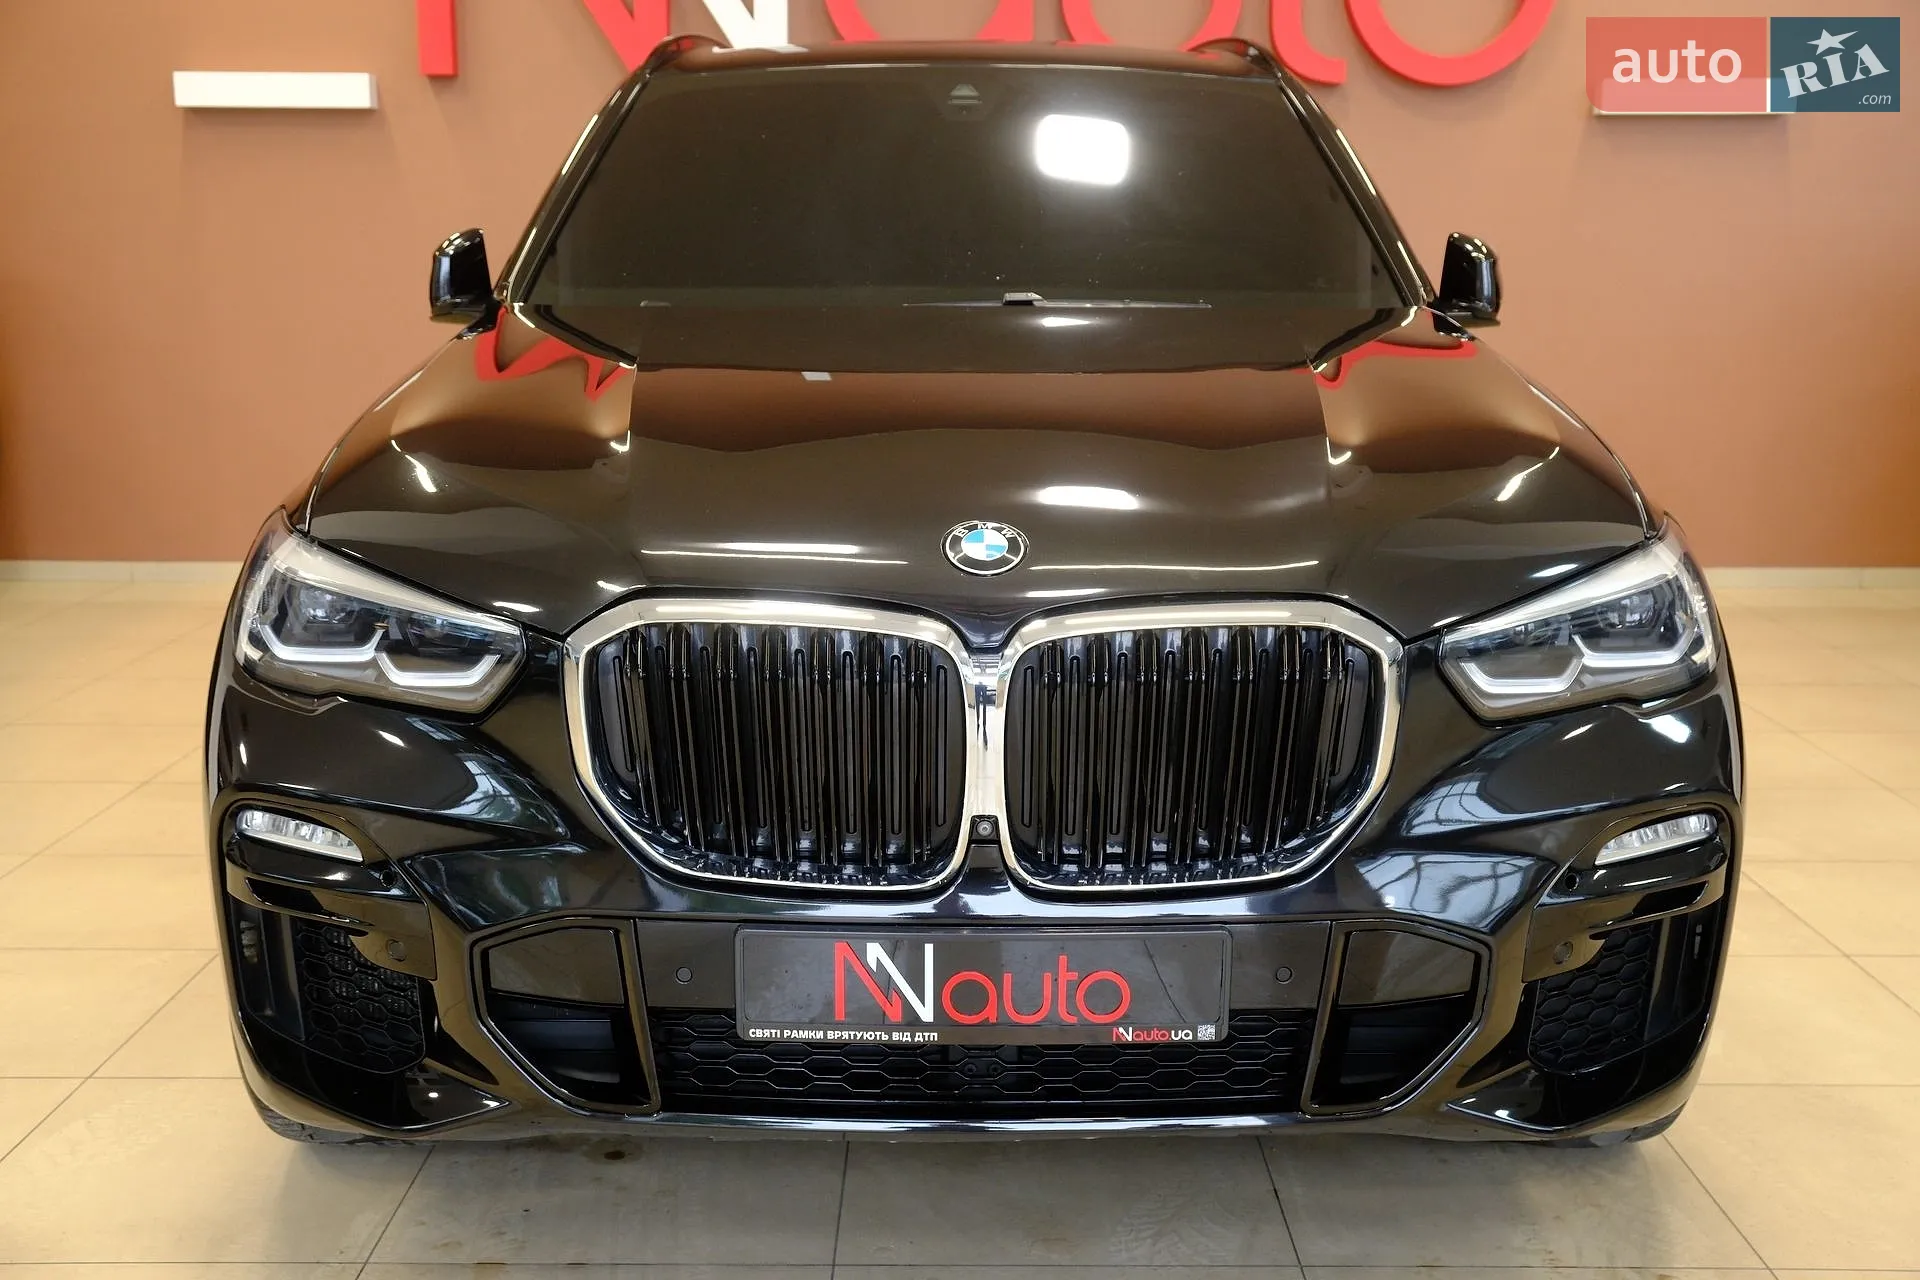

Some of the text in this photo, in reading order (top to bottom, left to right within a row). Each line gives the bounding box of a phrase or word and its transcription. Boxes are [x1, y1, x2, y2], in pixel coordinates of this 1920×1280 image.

[748, 1028, 938, 1042] СВЯТІ РАМКИ ВРЯТУЮТЬ ВІД ДТП
